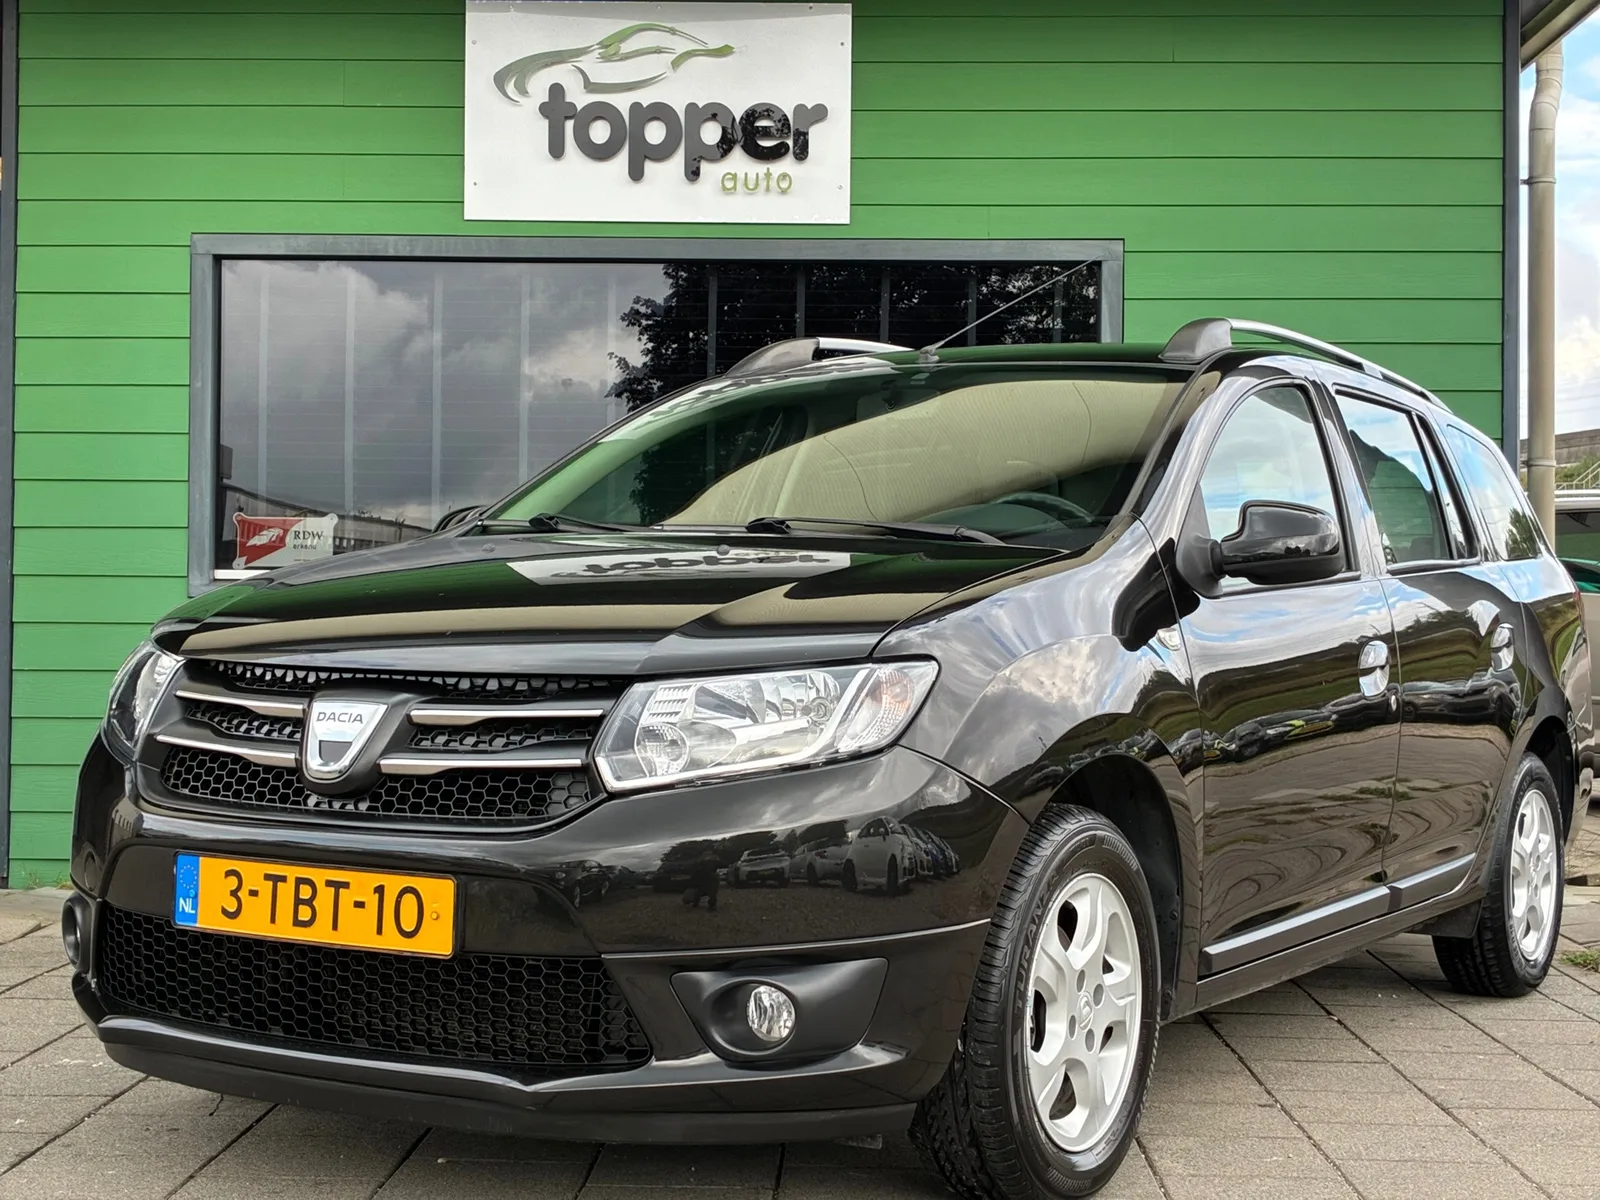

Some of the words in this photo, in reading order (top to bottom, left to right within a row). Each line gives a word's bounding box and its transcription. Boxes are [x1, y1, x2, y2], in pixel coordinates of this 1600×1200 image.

[538, 82, 829, 182] topper
[721, 167, 793, 193] auto
[293, 530, 325, 540] RDW
[315, 711, 364, 725] DACIA
[179, 897, 196, 914] NL
[220, 868, 425, 939] 3-TBT-10
